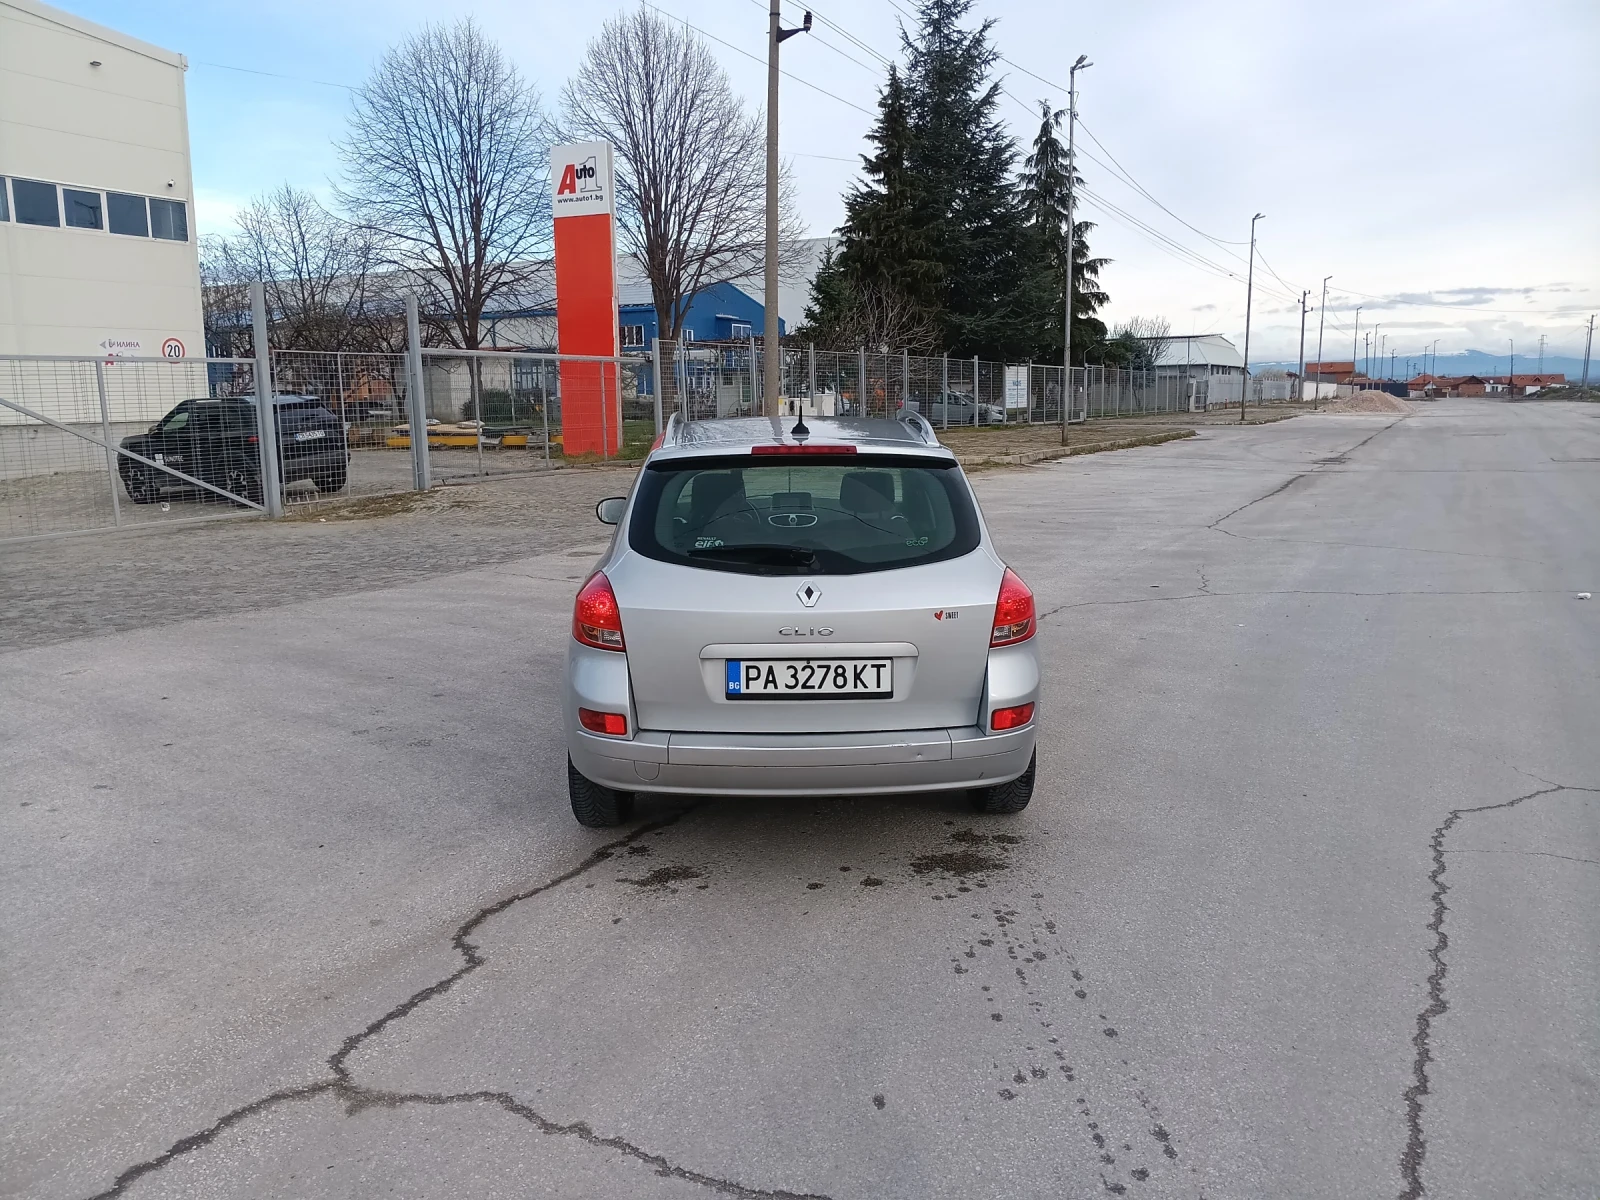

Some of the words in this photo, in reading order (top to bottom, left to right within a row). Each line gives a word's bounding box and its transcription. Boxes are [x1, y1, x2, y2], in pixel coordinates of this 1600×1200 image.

[557, 194, 603, 203] www.auto1.bg
[167, 344, 180, 357] 20
[779, 626, 834, 636] CLIO
[745, 665, 779, 690] PA
[784, 664, 848, 690] 3278
[853, 664, 887, 689] KT
[728, 681, 740, 690] BG
